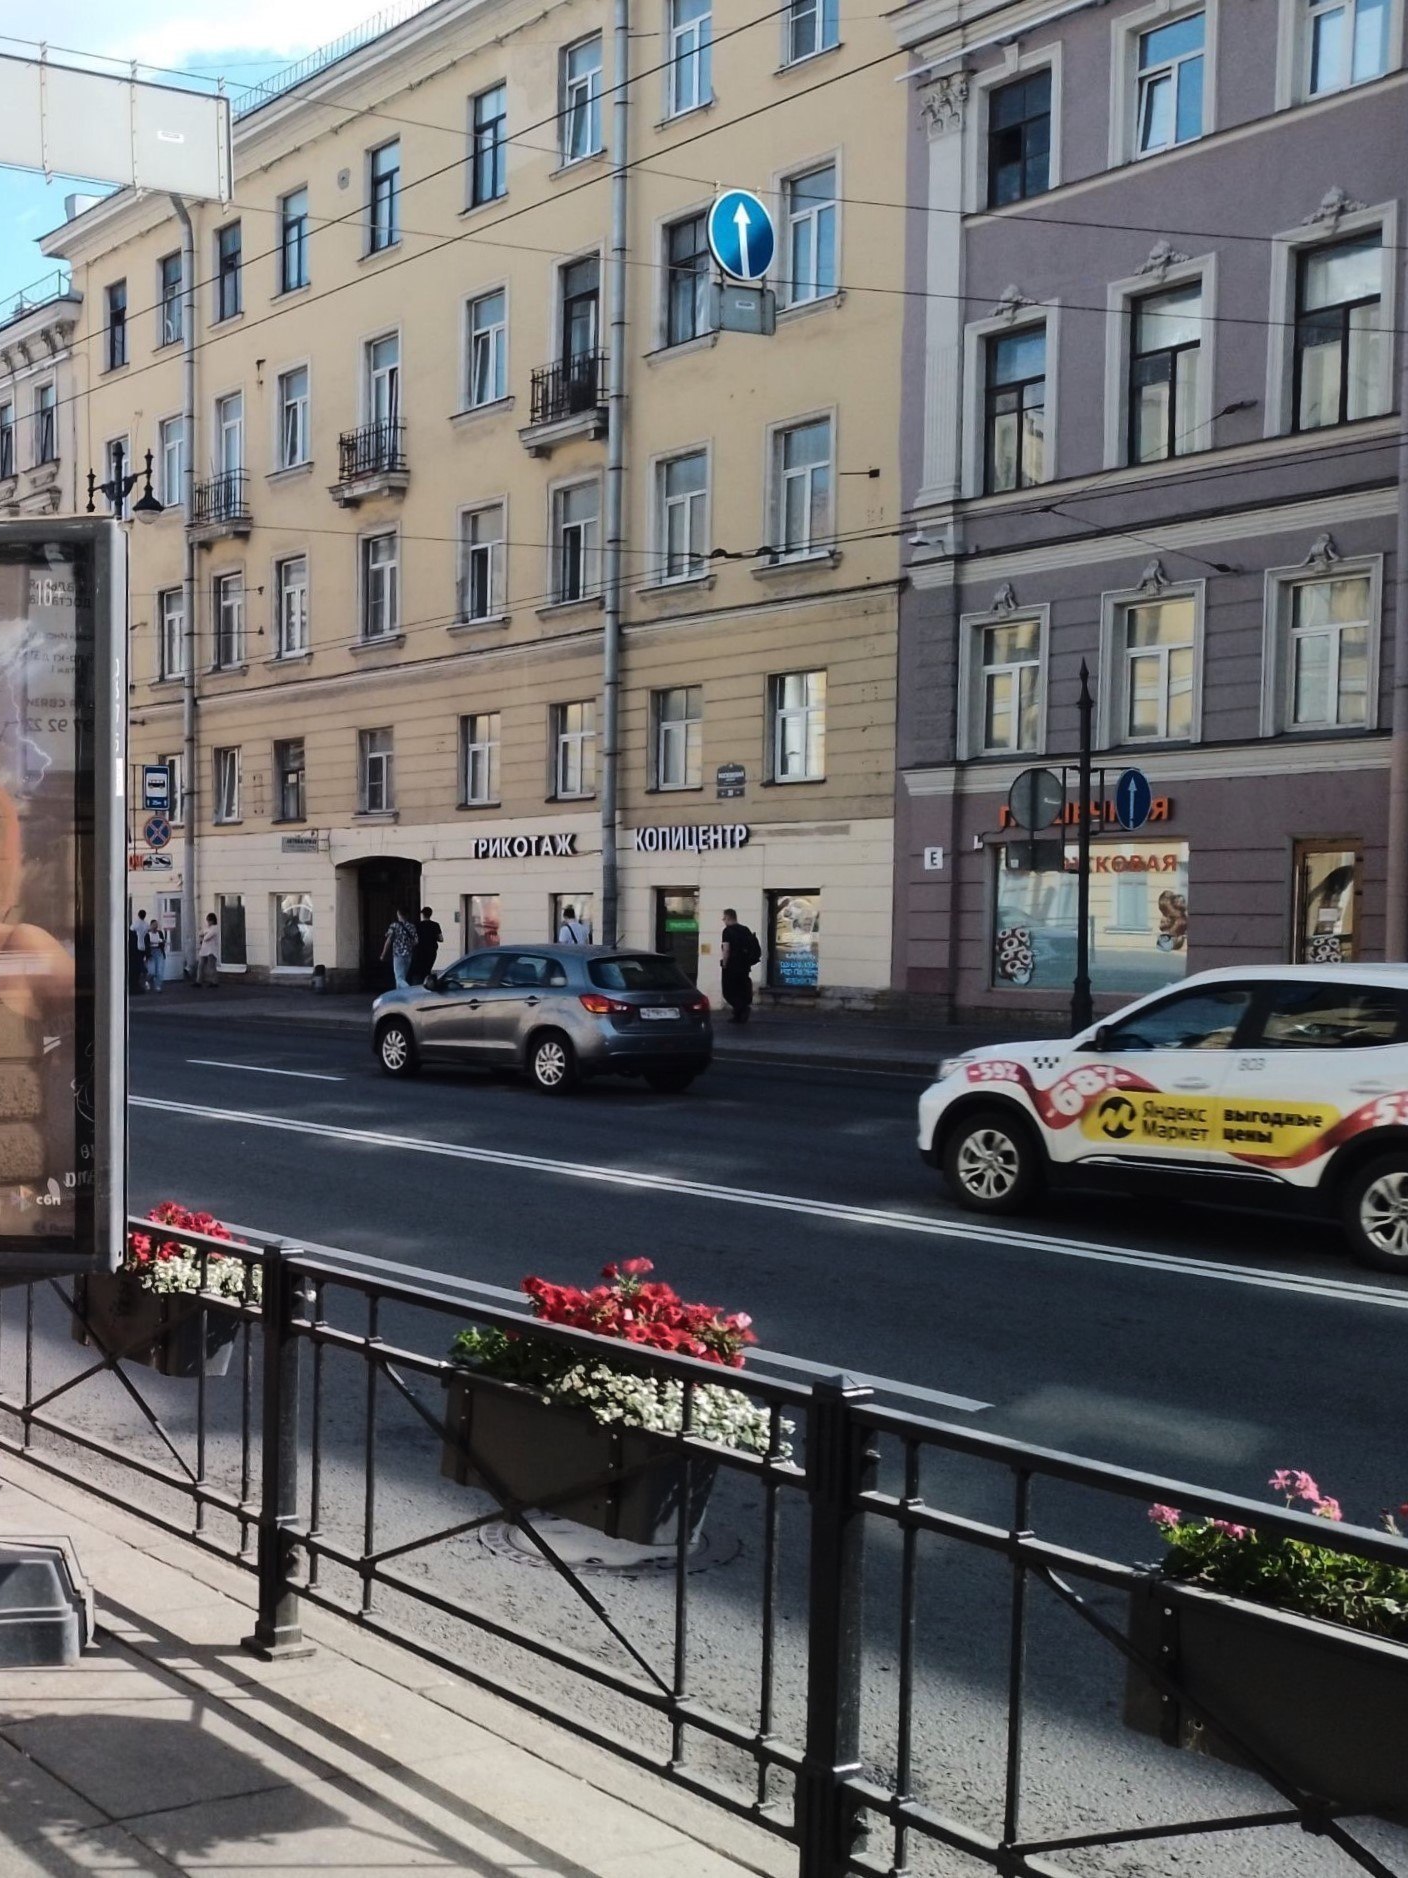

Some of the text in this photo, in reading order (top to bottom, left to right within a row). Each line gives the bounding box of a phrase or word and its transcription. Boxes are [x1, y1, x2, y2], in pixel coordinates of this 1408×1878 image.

[36, 578, 65, 607] 16+
[471, 834, 574, 859] ТРИКОТАЖ
[634, 824, 749, 853] КОПИЦЕНТР
[1143, 1100, 1207, 1123] Яндекс
[1224, 1108, 1323, 1129] выгодные
[1143, 1119, 1209, 1142] Маркет
[1223, 1127, 1273, 1144] цены
[36, 1194, 61, 1206] сбп
